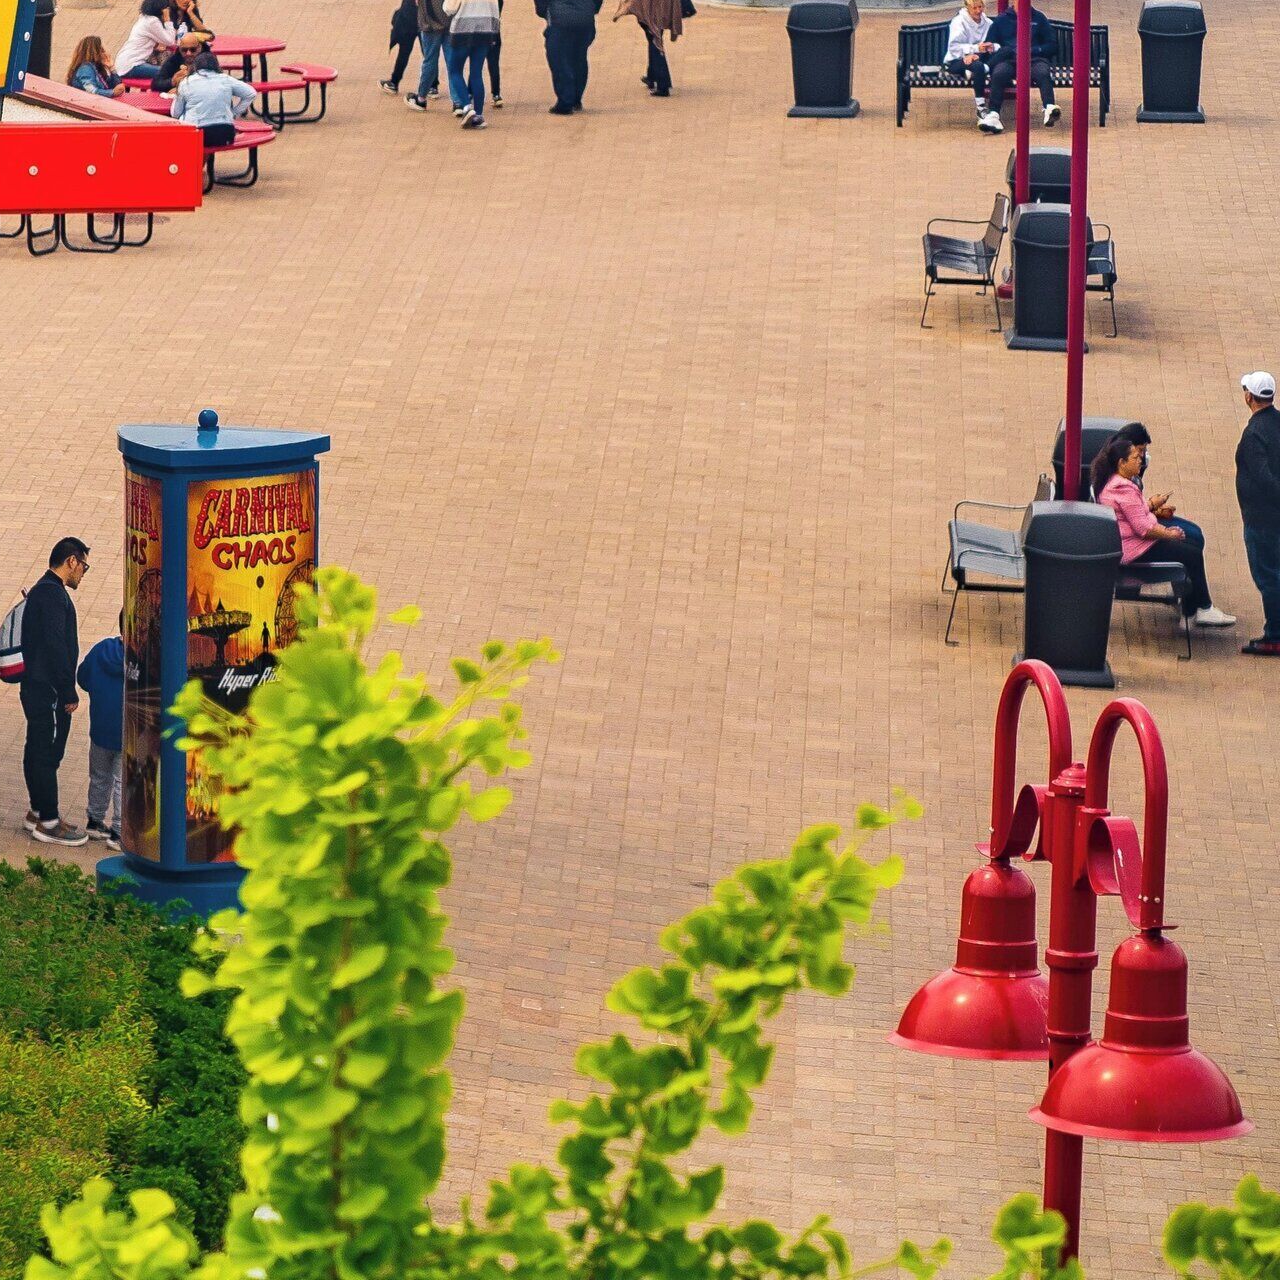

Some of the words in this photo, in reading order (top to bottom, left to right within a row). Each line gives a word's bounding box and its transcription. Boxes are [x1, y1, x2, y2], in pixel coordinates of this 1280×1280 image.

[193, 482, 311, 550] CARNIVAL
[211, 535, 297, 571] CHAOS
[217, 667, 259, 696] Hyper
